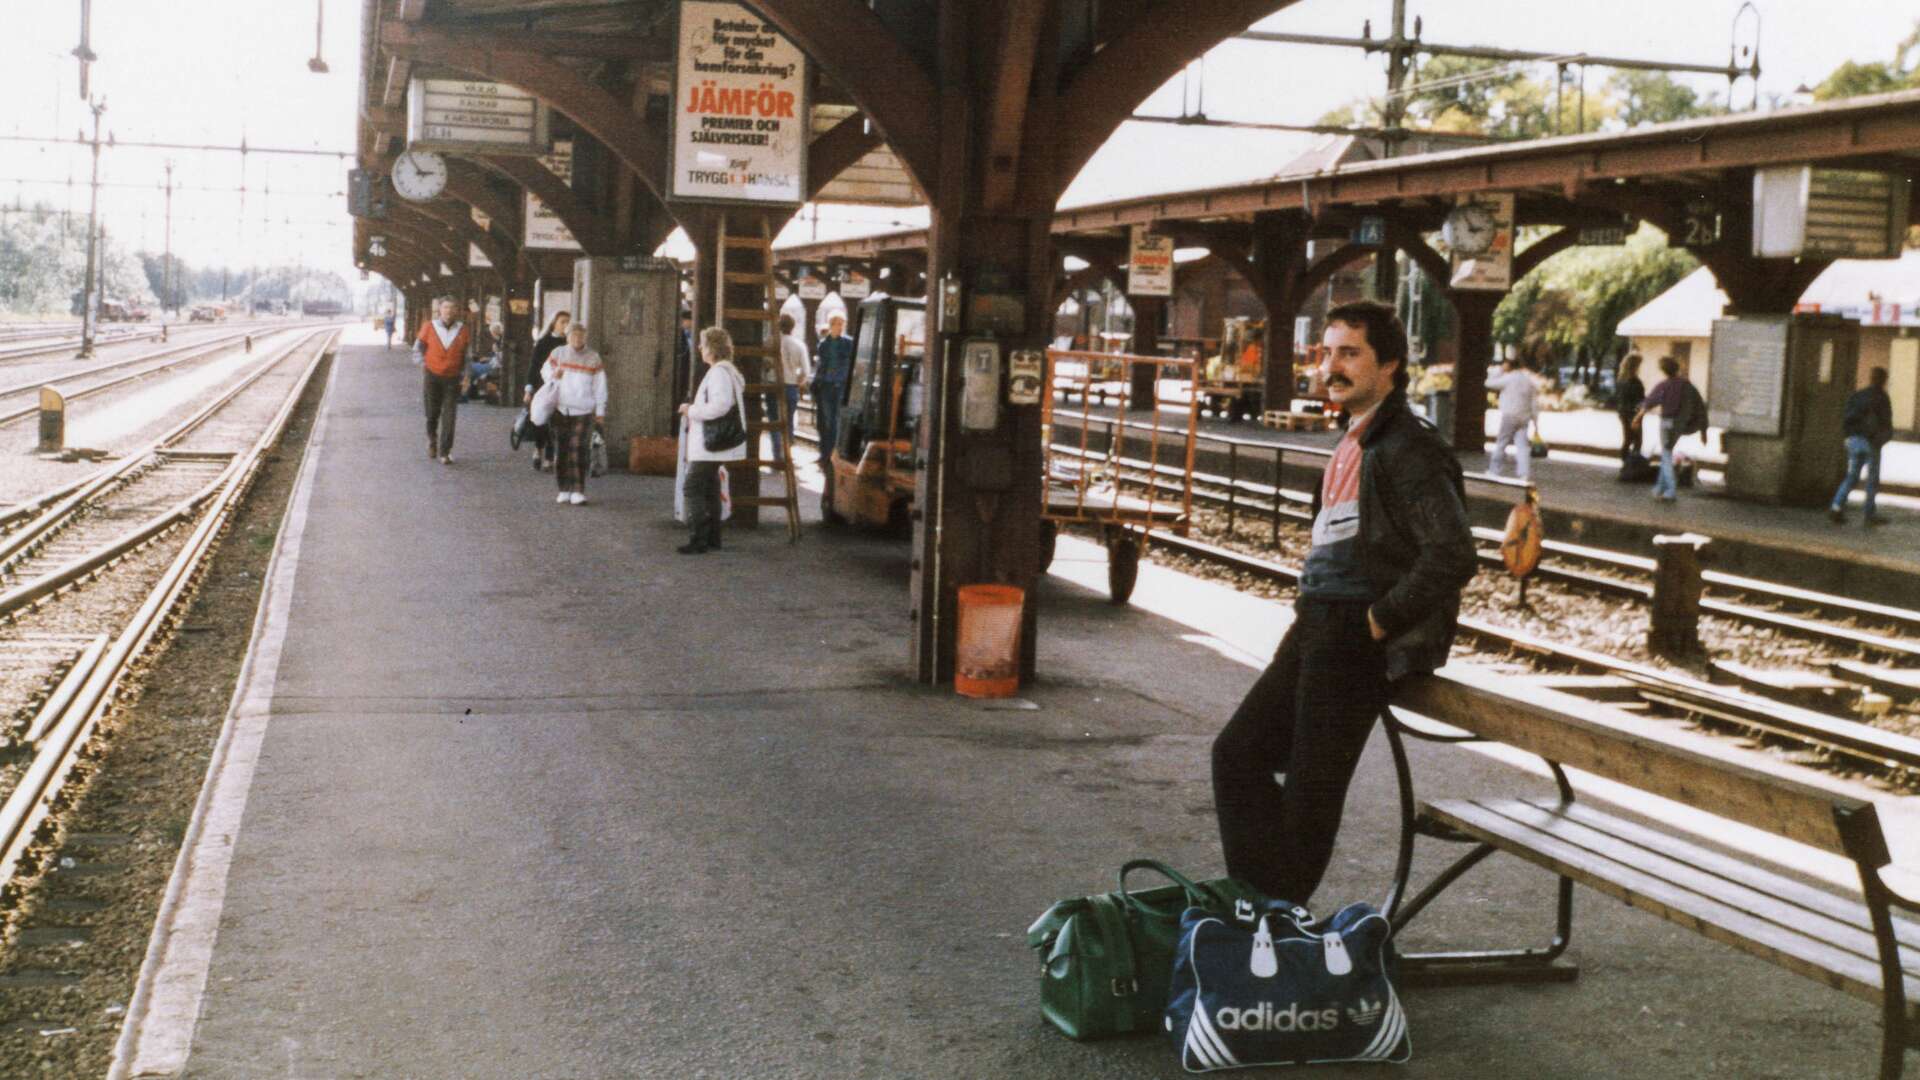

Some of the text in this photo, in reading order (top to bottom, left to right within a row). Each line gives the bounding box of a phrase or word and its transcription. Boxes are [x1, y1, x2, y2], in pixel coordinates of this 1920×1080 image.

[713, 32, 776, 49] för mycket
[724, 46, 741, 59] för
[687, 79, 795, 118] JÄMFÖR
[702, 117, 780, 132] PREMIER OCH
[691, 129, 769, 146] SJÄLVRISKER!
[688, 170, 728, 185] TRYGG
[1216, 1001, 1339, 1032] adidas
